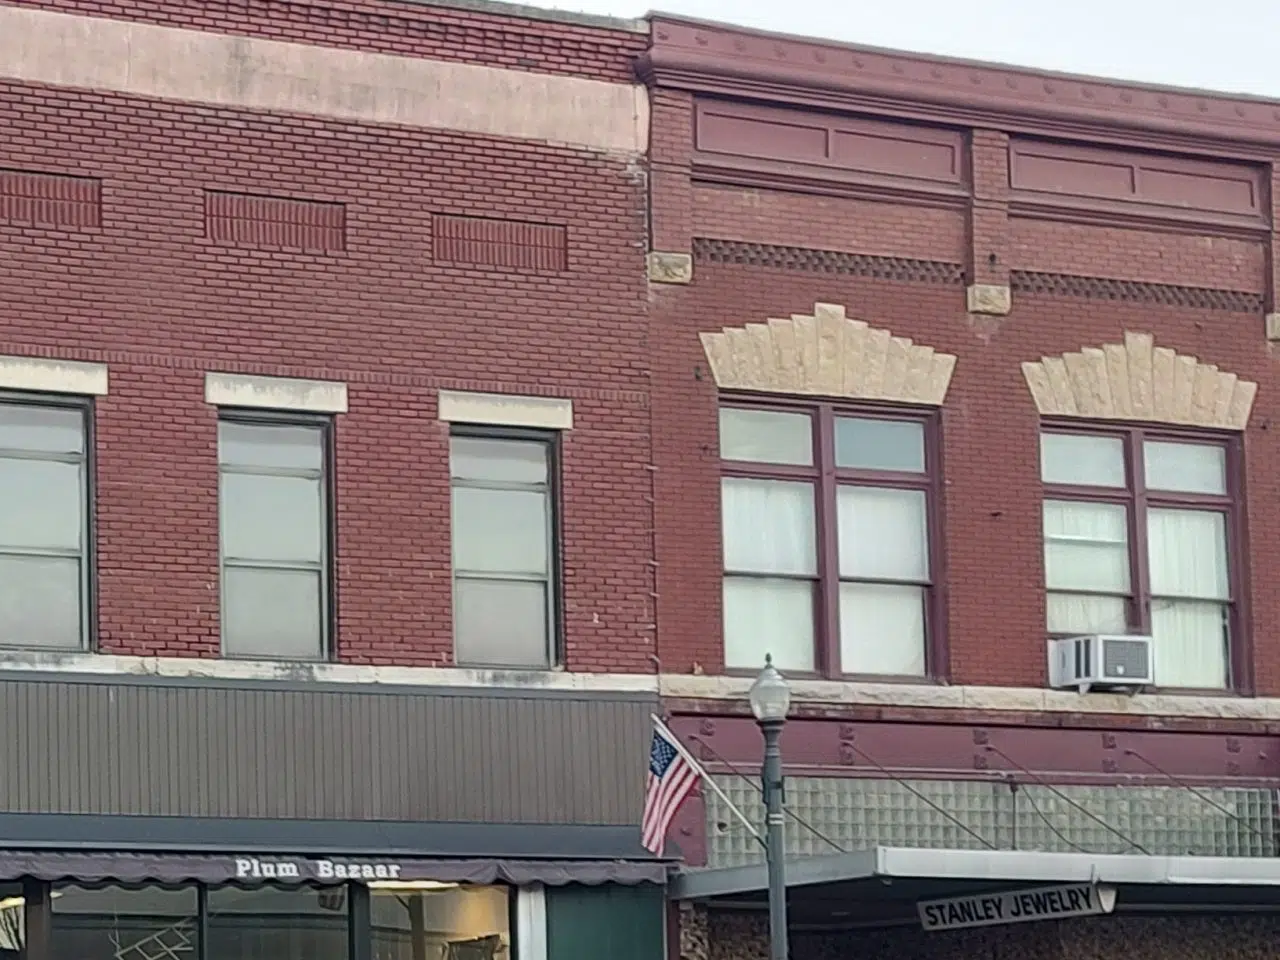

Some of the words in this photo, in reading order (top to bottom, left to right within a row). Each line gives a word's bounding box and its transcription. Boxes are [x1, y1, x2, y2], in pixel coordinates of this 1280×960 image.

[235, 859, 299, 878] Plum
[317, 860, 401, 879] Bazaar
[925, 897, 1004, 927] STANLEY
[1010, 886, 1094, 917] JEWELRY
